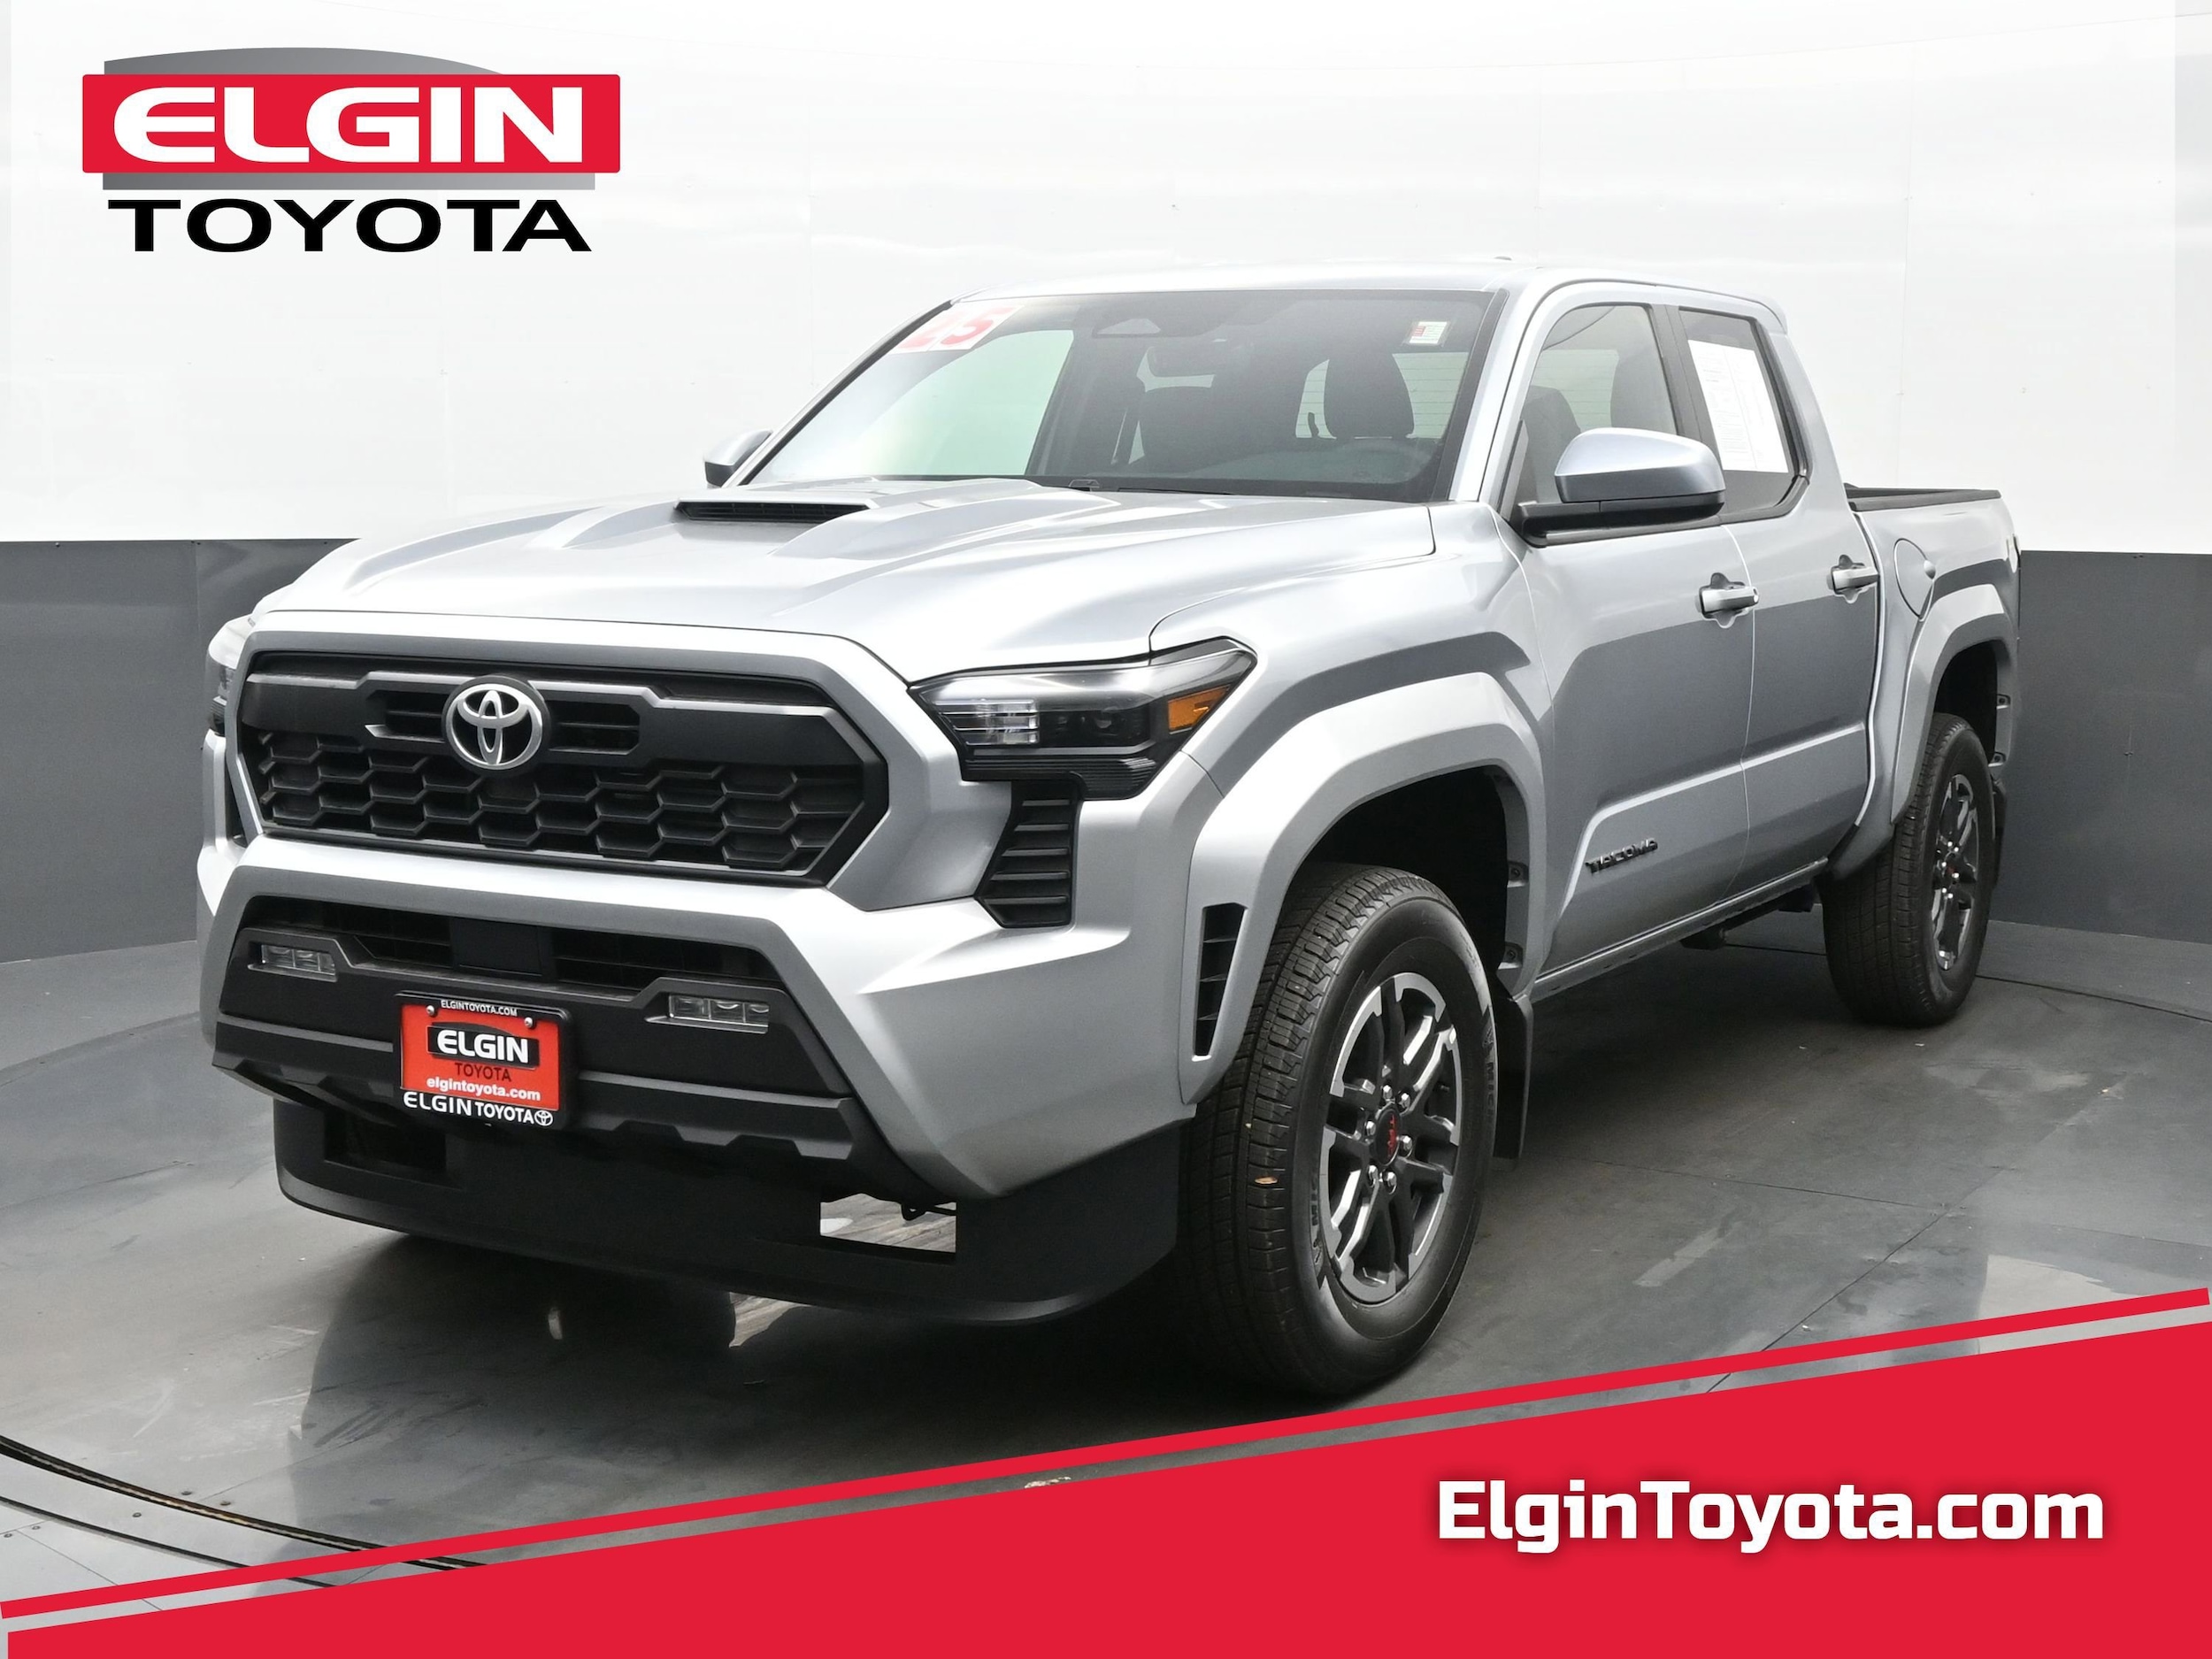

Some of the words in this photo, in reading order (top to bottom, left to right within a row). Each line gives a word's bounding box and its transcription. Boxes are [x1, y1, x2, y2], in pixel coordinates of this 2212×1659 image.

[441, 1000, 518, 1017] ELGINTOYOTA.COM
[437, 1029, 529, 1064] ELGIN
[455, 1063, 511, 1082] TOYOTA
[426, 1076, 541, 1101] elgintoyota.com
[403, 1091, 472, 1116] ELGIN
[474, 1102, 534, 1125] TOYOTA
